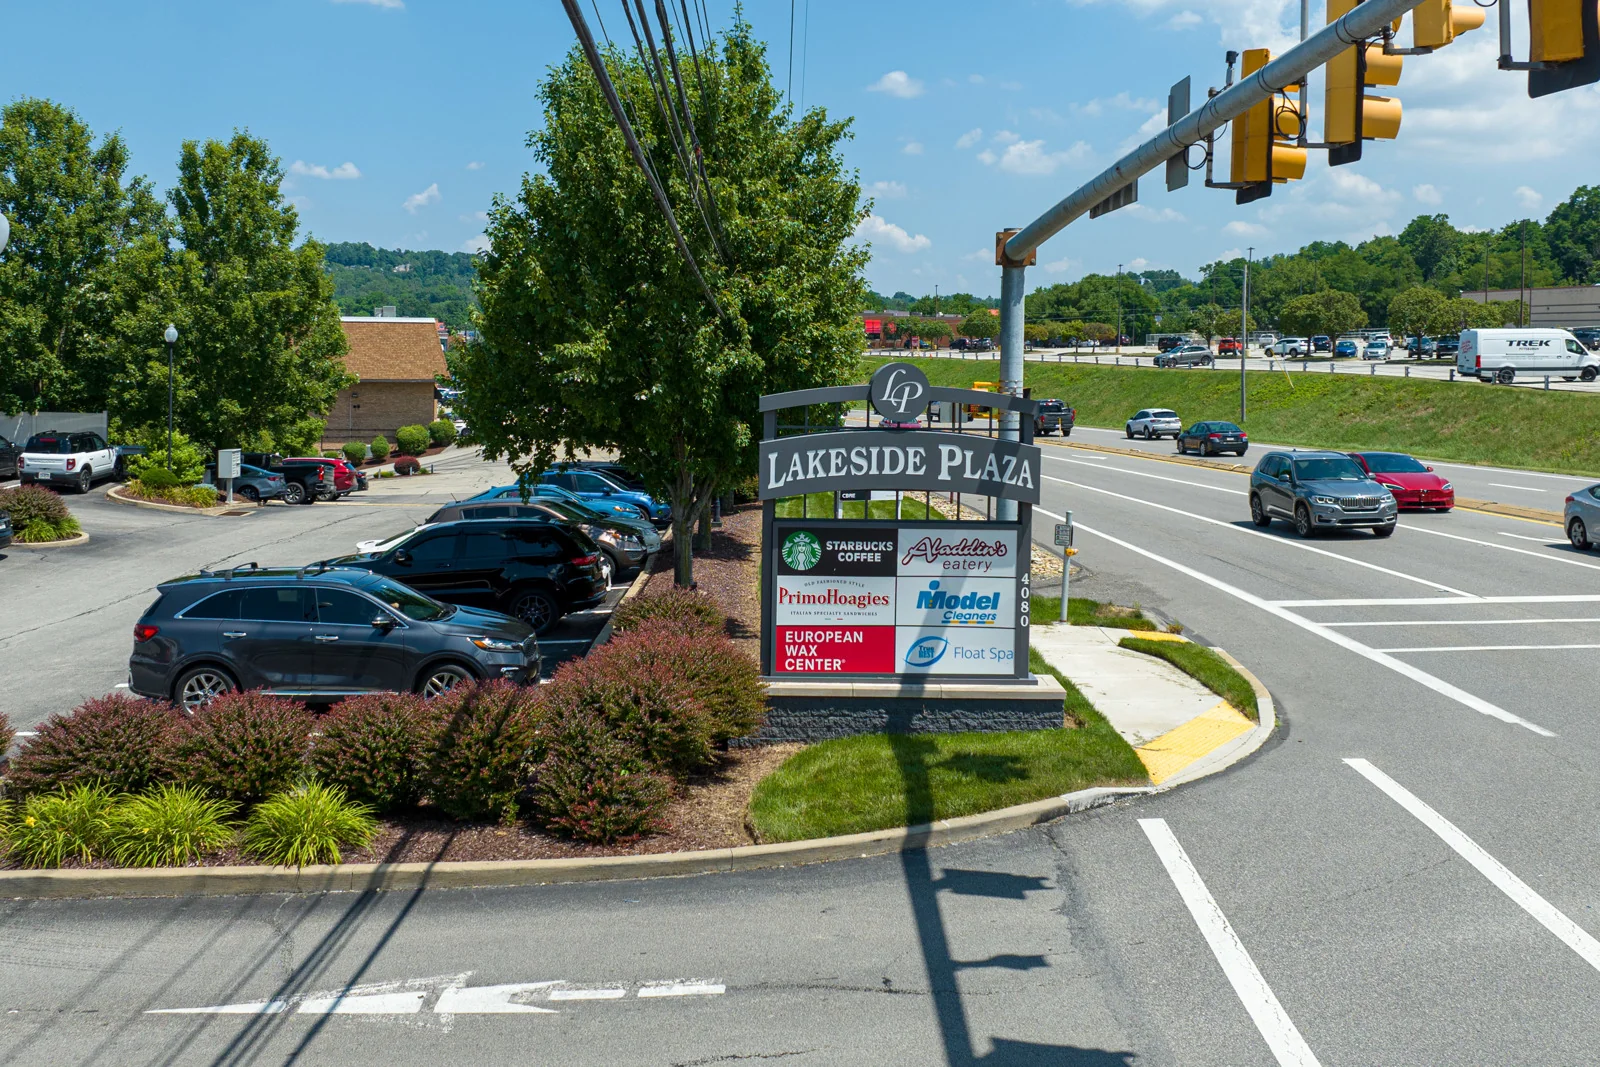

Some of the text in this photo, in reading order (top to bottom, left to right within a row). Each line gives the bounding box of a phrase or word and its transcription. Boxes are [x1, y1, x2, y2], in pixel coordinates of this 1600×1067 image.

[879, 368, 923, 414] LP
[767, 443, 1034, 490] LAKESIDE PLAZA
[826, 540, 894, 551] STARBUCKS
[901, 536, 1008, 566] Aladdin's
[838, 552, 881, 562] COFFEE
[942, 559, 992, 572] eatery
[779, 586, 890, 608] PrimoHoagies
[916, 589, 1000, 610] Model
[1020, 572, 1030, 627] 4080
[944, 610, 996, 620] Cleaners
[785, 630, 864, 643] EUROPEAN
[784, 644, 818, 656] WAX
[954, 646, 1014, 662] Float Spa
